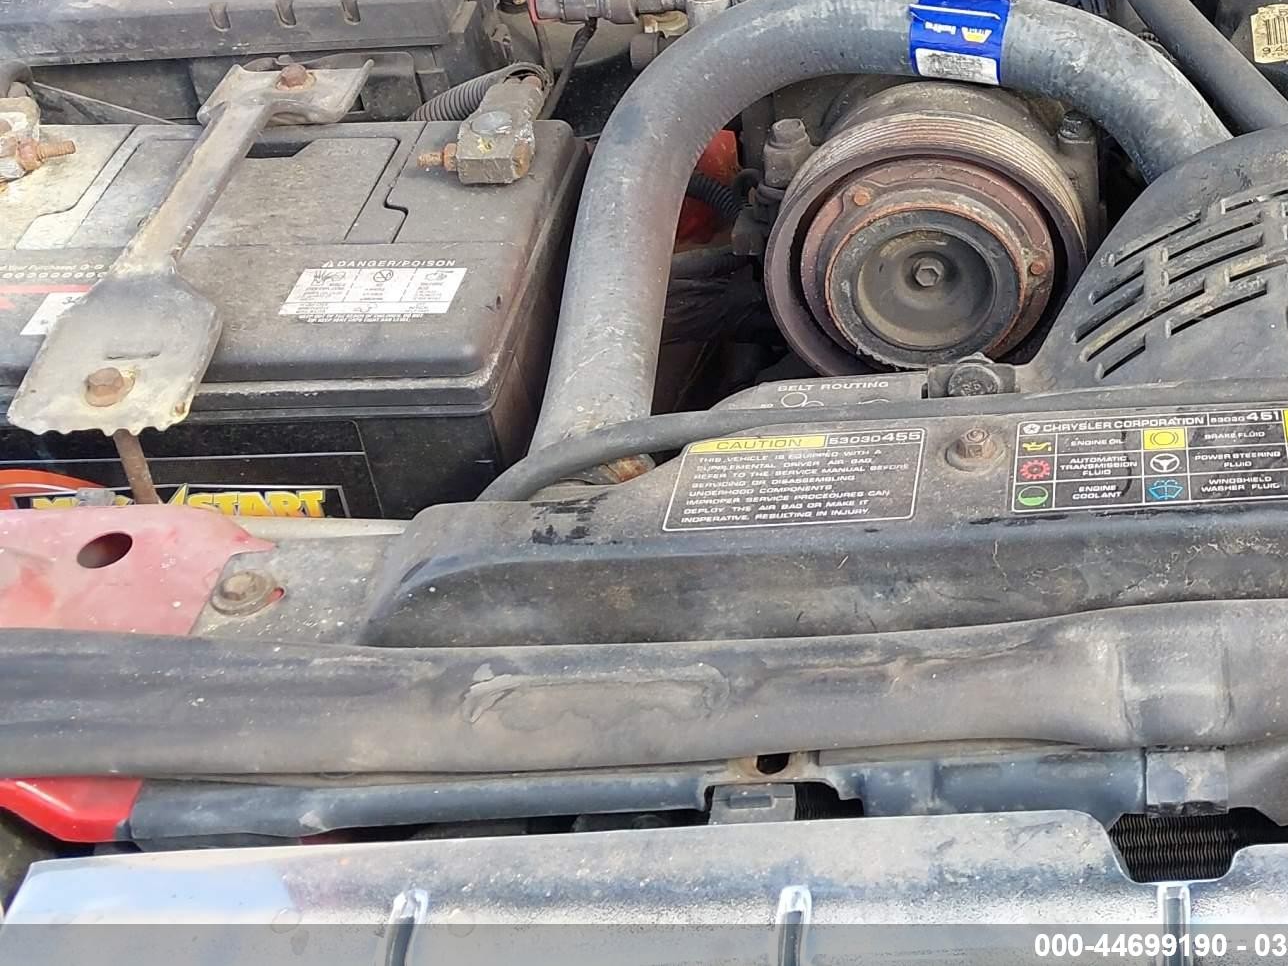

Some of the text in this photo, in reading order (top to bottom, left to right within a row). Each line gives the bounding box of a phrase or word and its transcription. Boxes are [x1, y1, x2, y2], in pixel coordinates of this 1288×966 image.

[777, 381, 889, 392] BELT ROUTING
[1043, 420, 1111, 433] CHRYSLER
[1113, 416, 1204, 428] CORPORATION
[716, 432, 921, 450] CAUTION 53030455
[1232, 451, 1281, 459] STEERING
[1070, 456, 1127, 464] AUTOMATIC
[1060, 461, 1138, 471] TRANSMISSION
[775, 468, 818, 476] SERVICE
[771, 475, 856, 485] DISASSEMBLING
[1208, 476, 1272, 485] WINDSHIELD
[1078, 484, 1117, 492] ENGINE
[1201, 482, 1280, 492] WASHER FLUID
[689, 489, 754, 497] UNDERHOOD
[745, 495, 789, 503] SERVICE
[794, 491, 864, 500] PROCEDURES
[1072, 491, 1122, 500] COOLANT
[755, 511, 813, 520] RESULTING
